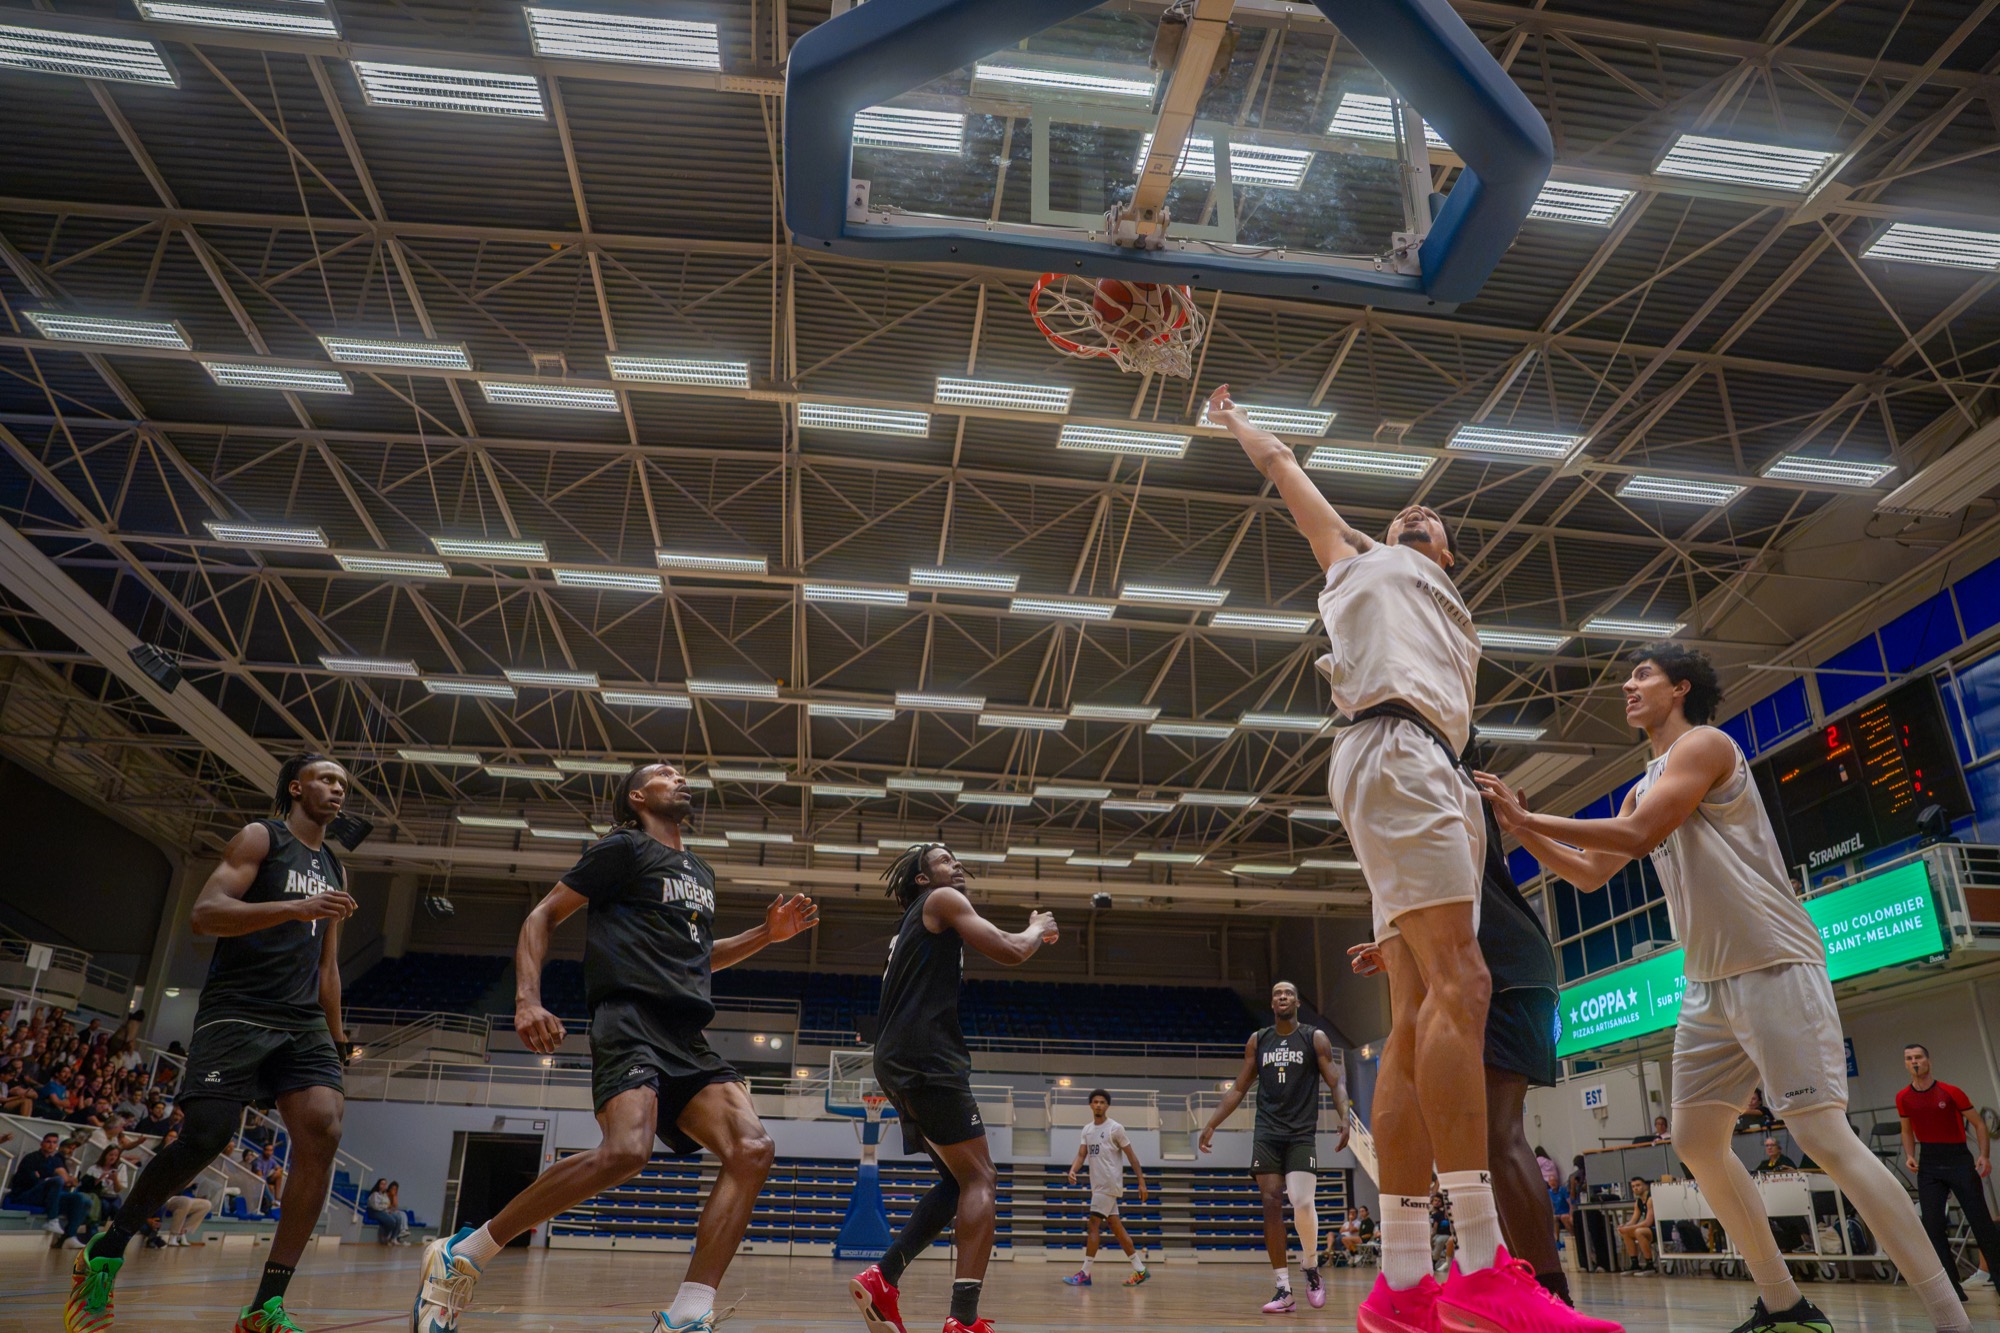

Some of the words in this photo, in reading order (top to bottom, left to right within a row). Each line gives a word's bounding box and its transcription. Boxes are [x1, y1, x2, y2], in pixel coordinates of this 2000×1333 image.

[1827, 725, 1839, 748] 2
[1809, 832, 1864, 868] STRAMATEL
[662, 877, 715, 914] ANGERS
[1832, 920, 1849, 935] DU
[1851, 896, 1925, 929] COLOMBIER
[687, 921, 700, 943] 12
[1828, 915, 1923, 954] SAINT-MELAINE
[1580, 989, 1627, 1022] COPPA
[1657, 994, 1673, 1008] SUR
[1573, 1026, 1595, 1039] PIZZAS
[1595, 1012, 1640, 1032] ARTISANALES
[1262, 1050, 1304, 1067] ANGERS
[1277, 1072, 1286, 1083] 11
[1585, 1088, 1602, 1106] EST
[1785, 1088, 1809, 1099] CRAFT
